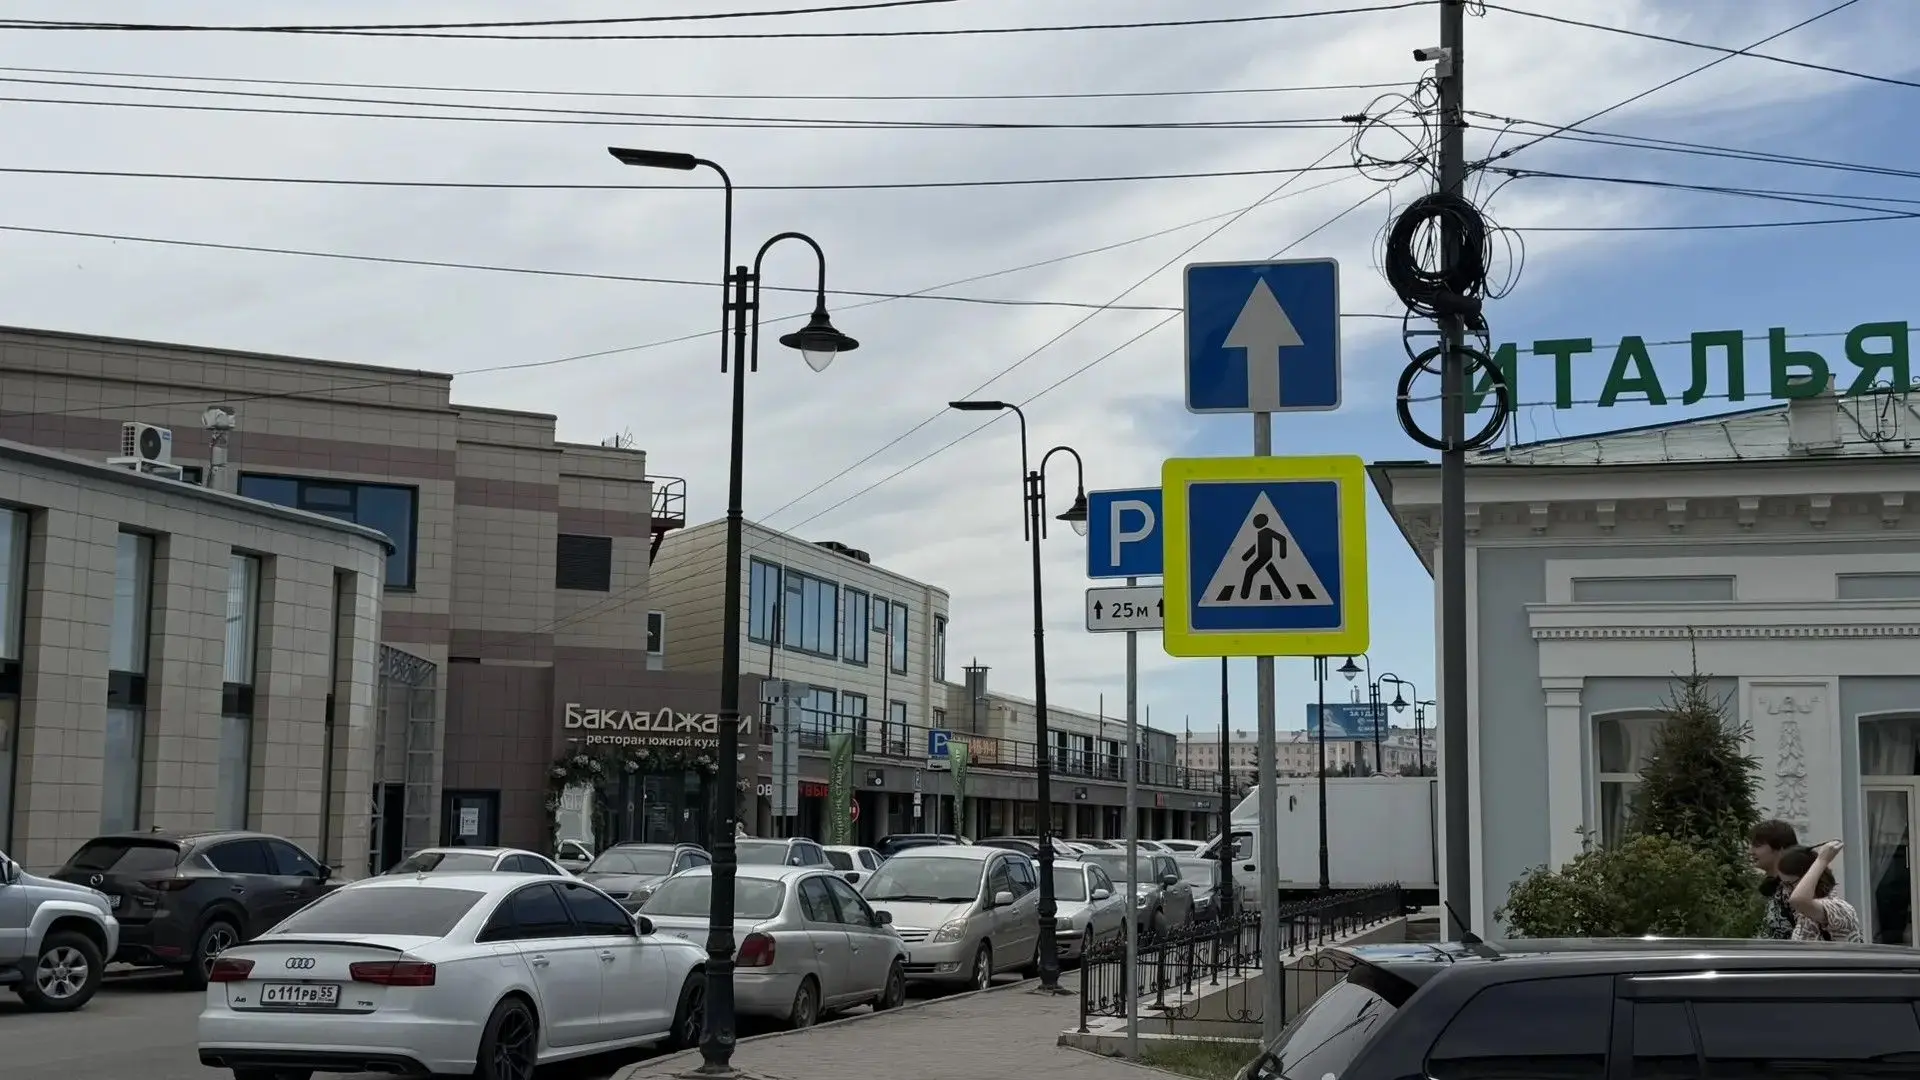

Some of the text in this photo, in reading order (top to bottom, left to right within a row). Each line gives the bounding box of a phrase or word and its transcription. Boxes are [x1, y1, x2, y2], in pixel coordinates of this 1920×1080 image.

[1110, 499, 1155, 567] P
[565, 702, 752, 735] БаклаДжаи
[586, 734, 645, 747] ресторан
[648, 735, 692, 747] южной
[934, 732, 948, 753] P
